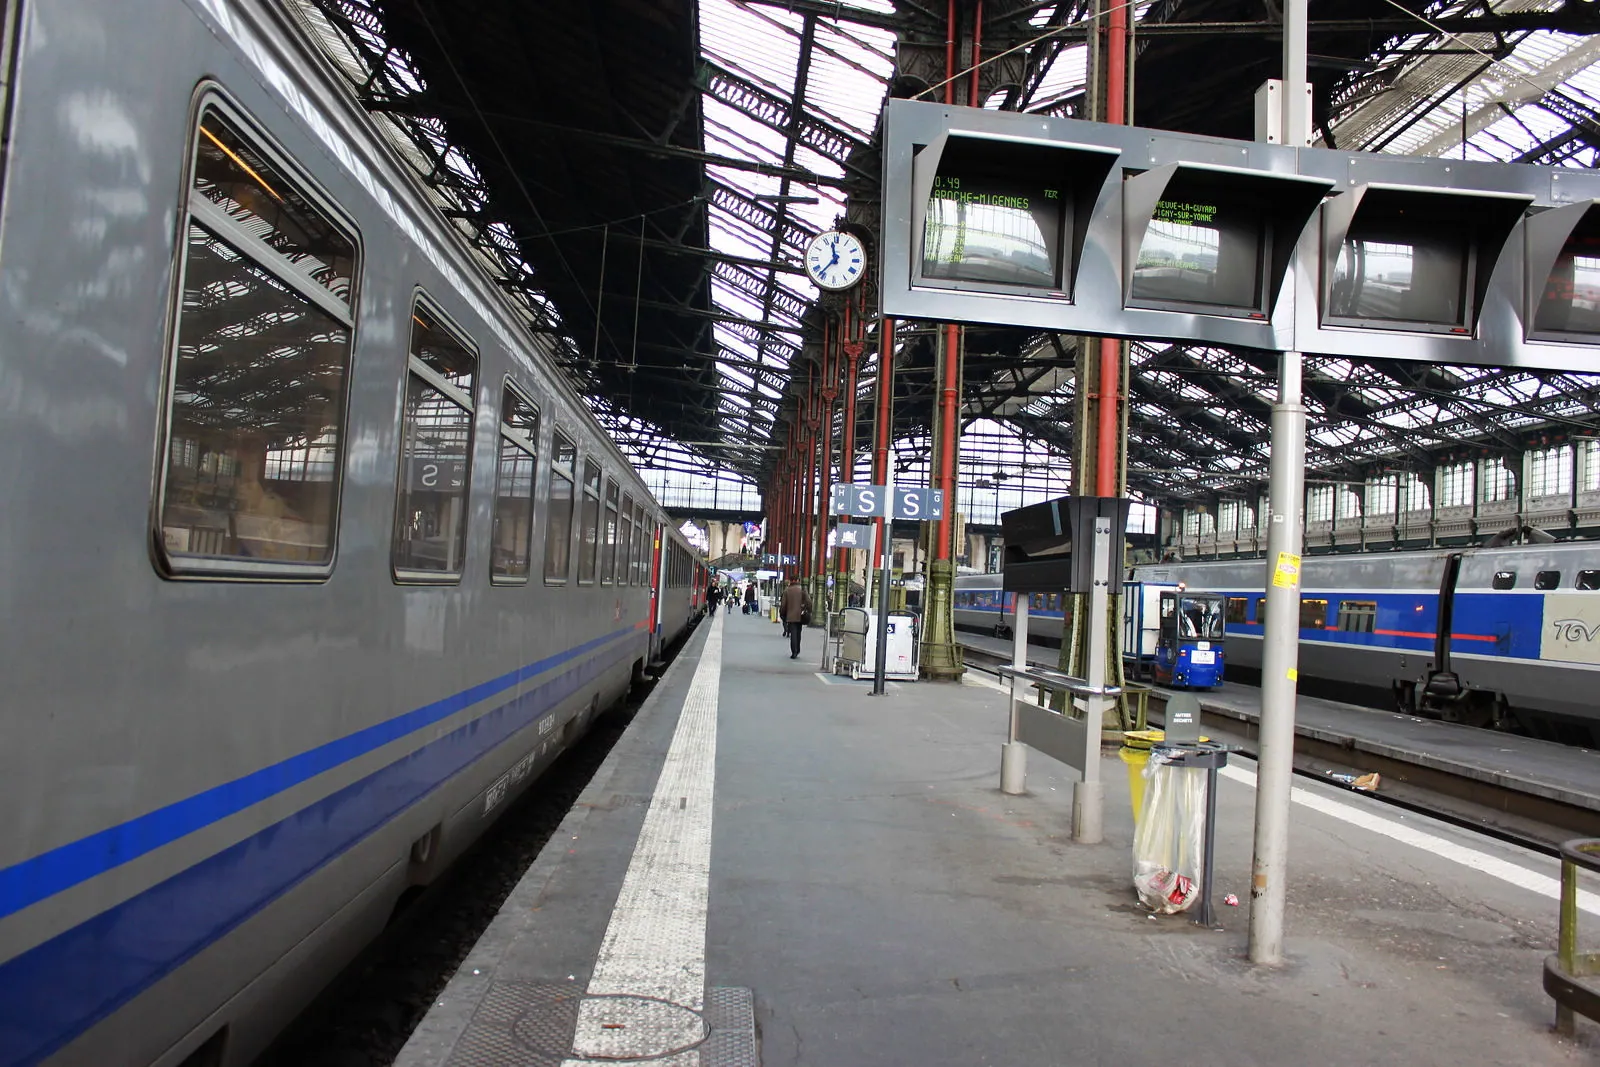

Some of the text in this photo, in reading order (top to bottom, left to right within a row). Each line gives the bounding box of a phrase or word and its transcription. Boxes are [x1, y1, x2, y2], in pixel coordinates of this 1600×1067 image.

[1044, 189, 1058, 199] TER
[858, 490, 875, 513] S
[902, 493, 941, 516] S G
[1553, 618, 1600, 642] TGV
